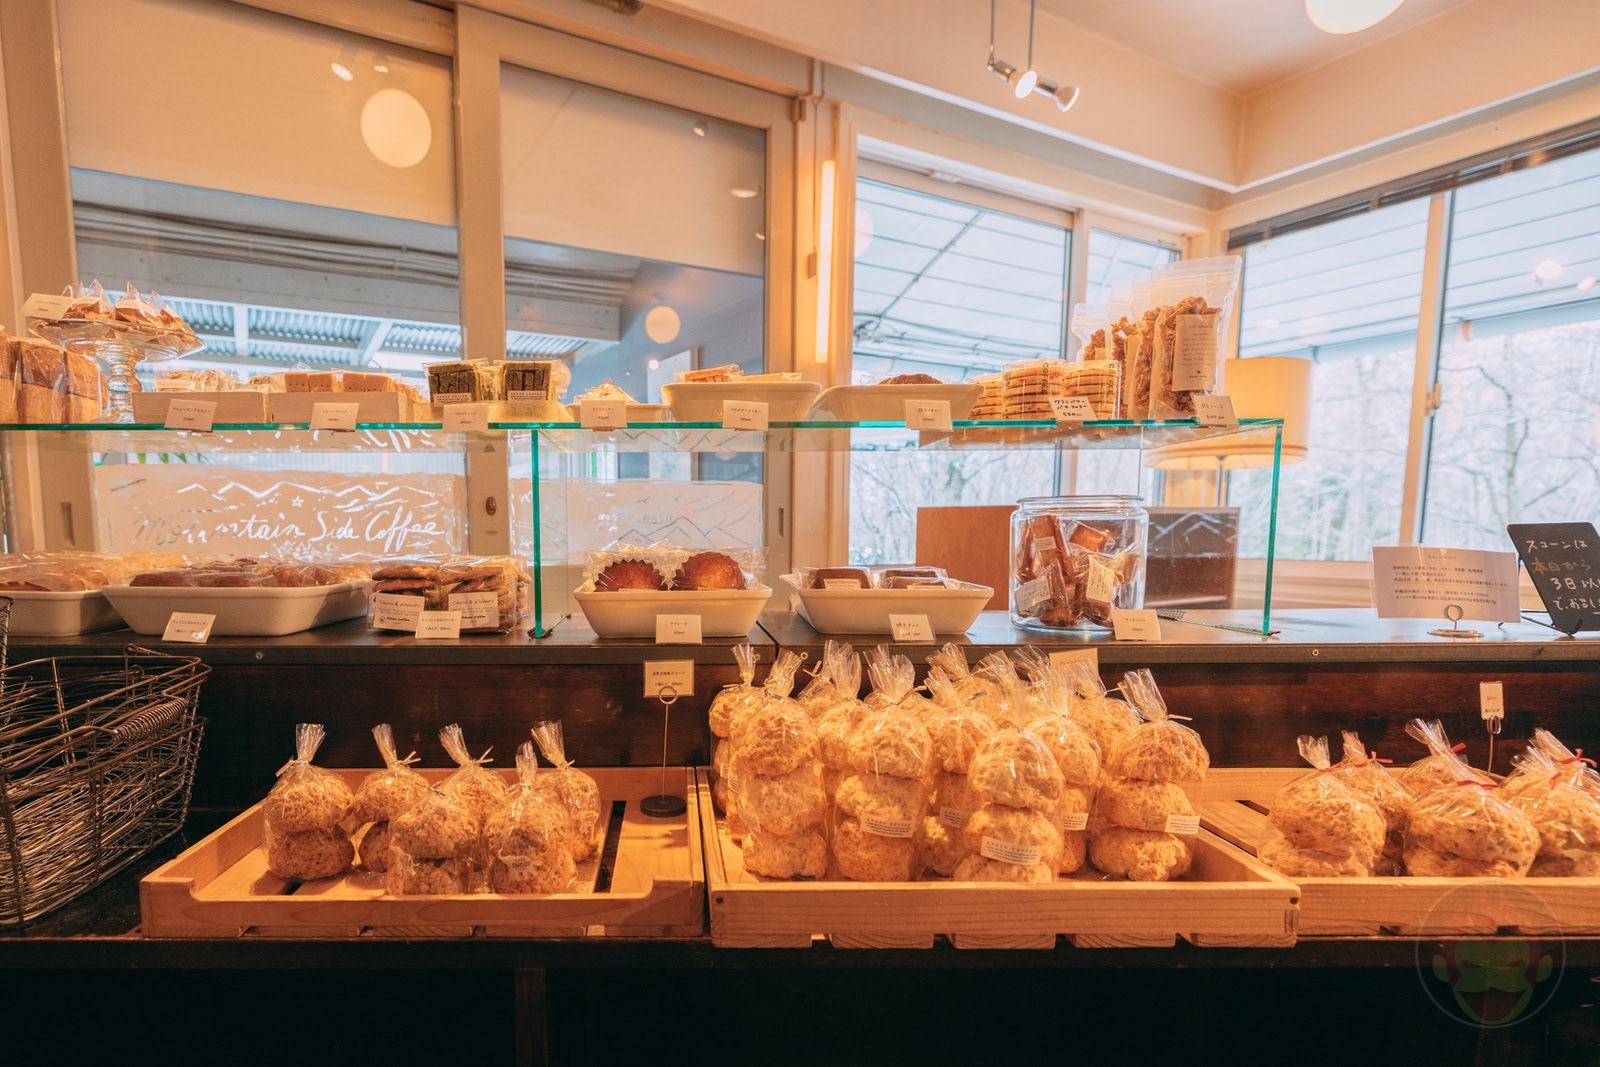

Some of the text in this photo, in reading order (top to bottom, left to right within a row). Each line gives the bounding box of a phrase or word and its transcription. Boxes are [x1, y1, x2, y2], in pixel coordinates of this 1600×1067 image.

[308, 511, 360, 542] Side
[365, 505, 444, 553] Coffee
[1525, 539, 1588, 554] スコーンは
[1531, 557, 1591, 576] 本日から
[1550, 577, 1600, 590] 3日以
